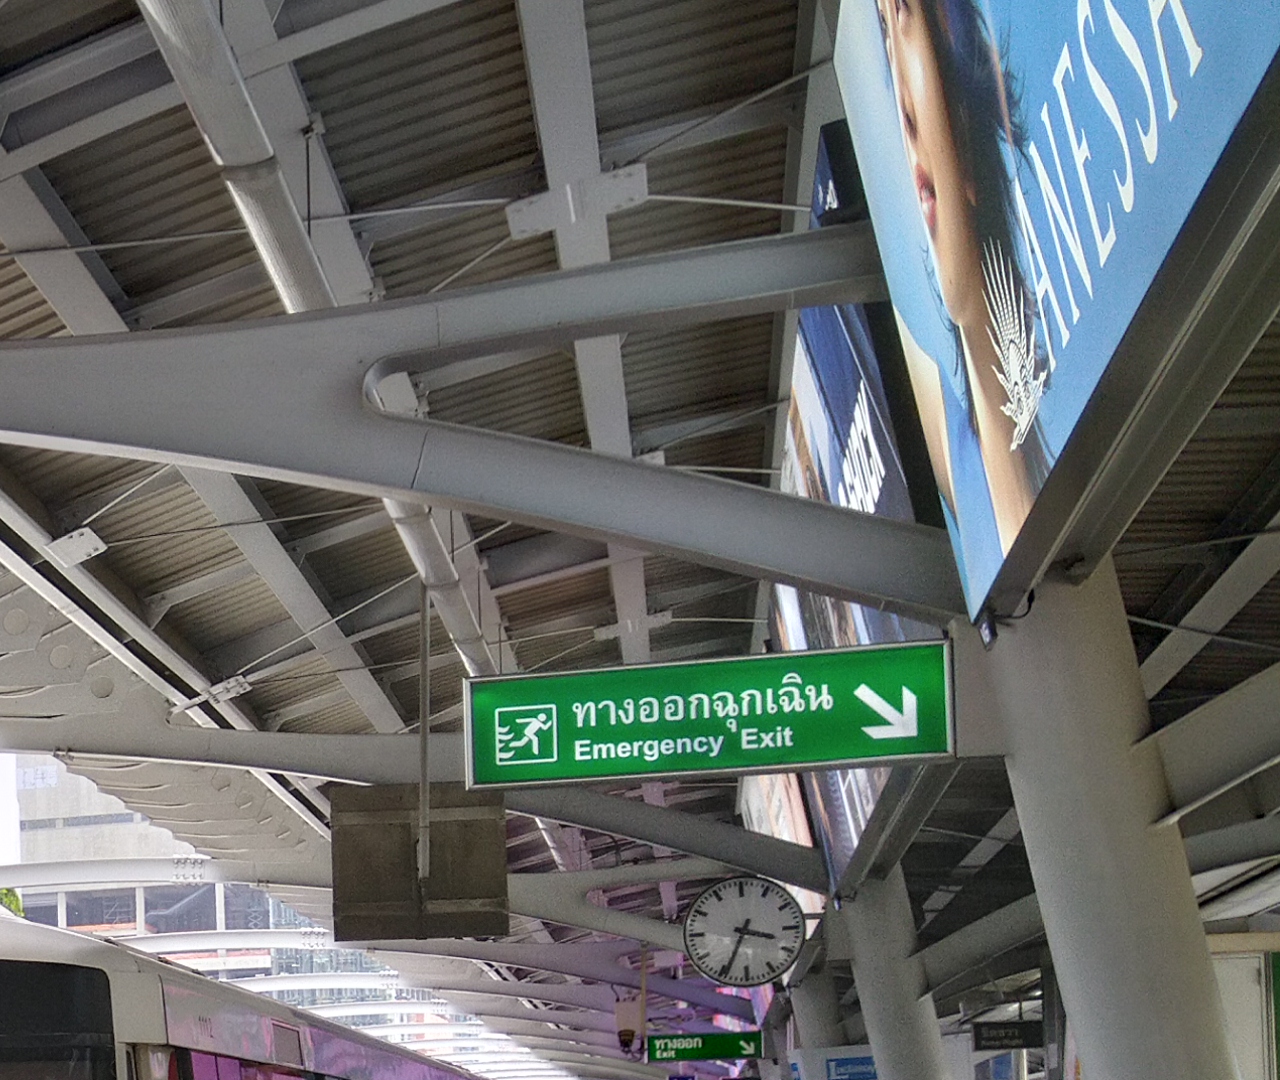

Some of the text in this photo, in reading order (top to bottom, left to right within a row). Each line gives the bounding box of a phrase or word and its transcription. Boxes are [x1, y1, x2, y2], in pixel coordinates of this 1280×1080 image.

[571, 672, 834, 731] ทางออกฉุกเฉิน
[573, 727, 794, 762] Emergency Exit
[654, 1037, 703, 1050] ทางออก
[655, 1050, 676, 1059] Exit
